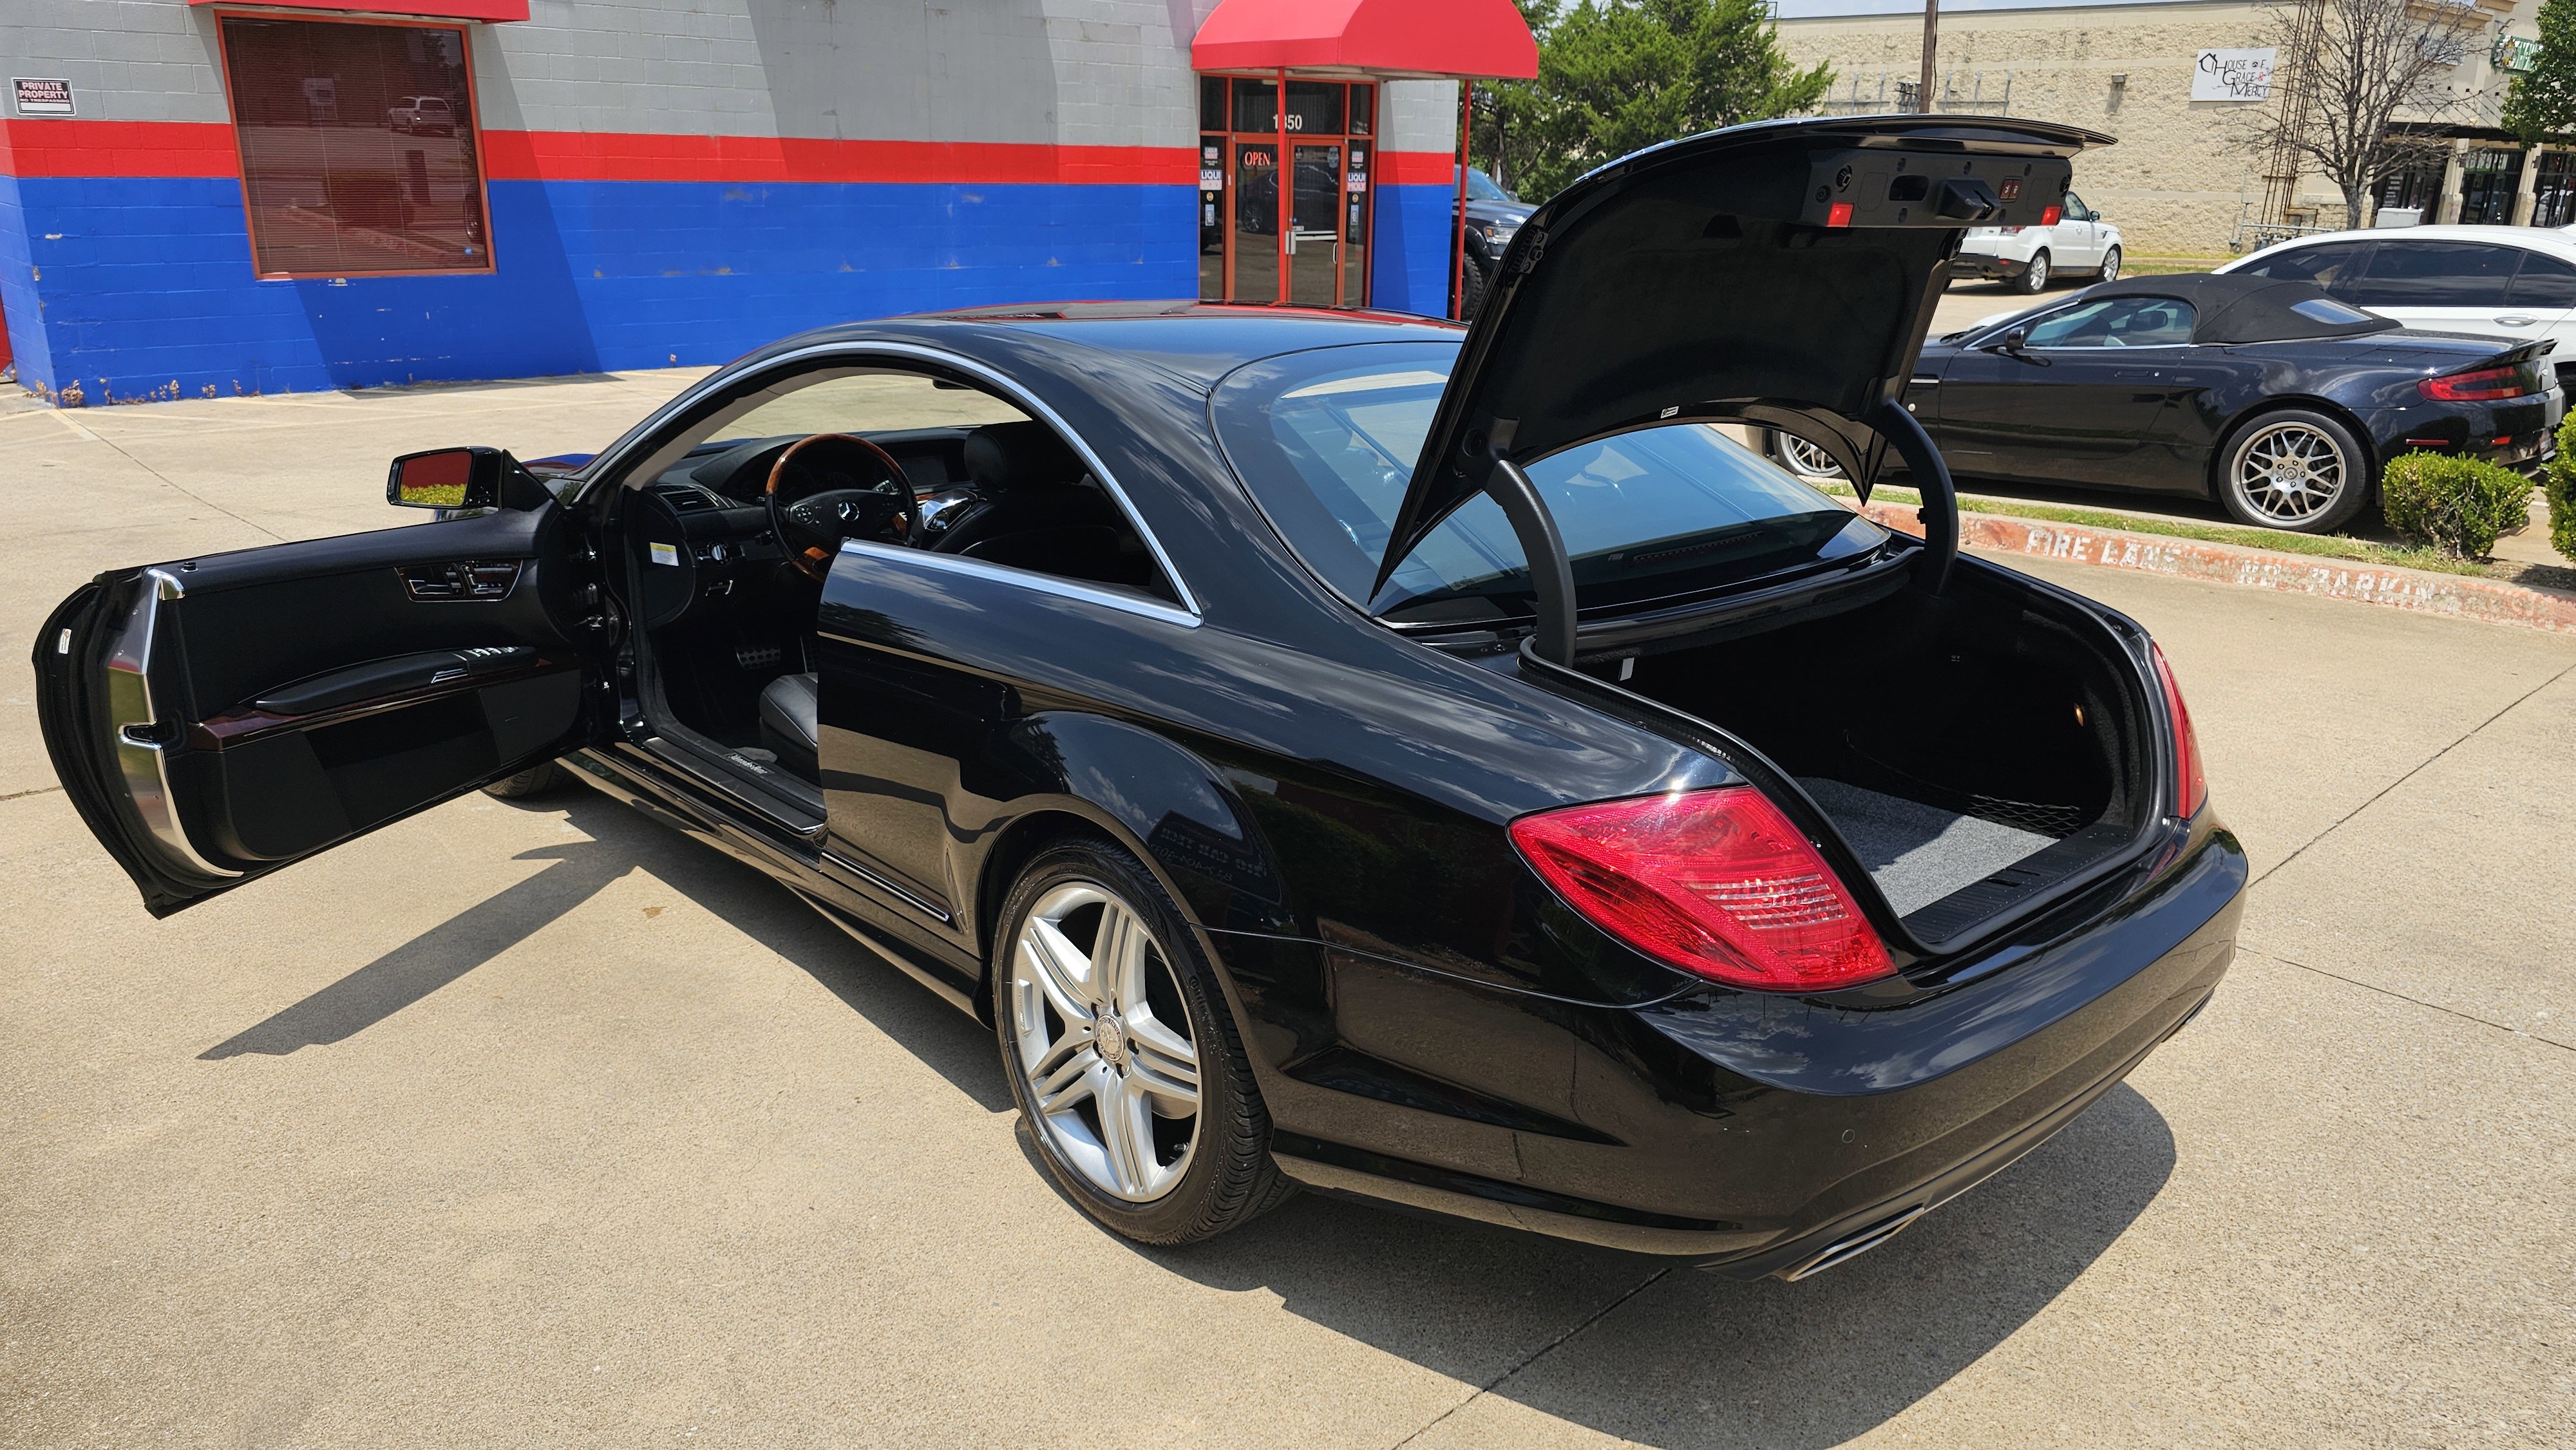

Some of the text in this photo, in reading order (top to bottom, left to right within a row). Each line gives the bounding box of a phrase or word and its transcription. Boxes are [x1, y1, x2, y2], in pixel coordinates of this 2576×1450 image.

[2222, 70, 2264, 85] GRACE &
[21, 82, 63, 90] PRIVATE
[2230, 82, 2268, 99] MERCY
[18, 89, 68, 99] PROPERTY
[1244, 151, 1271, 166] OPEN
[1201, 170, 1221, 180] LIQUI
[1348, 172, 1367, 182] LIQUI
[2025, 529, 2092, 561] FIRE
